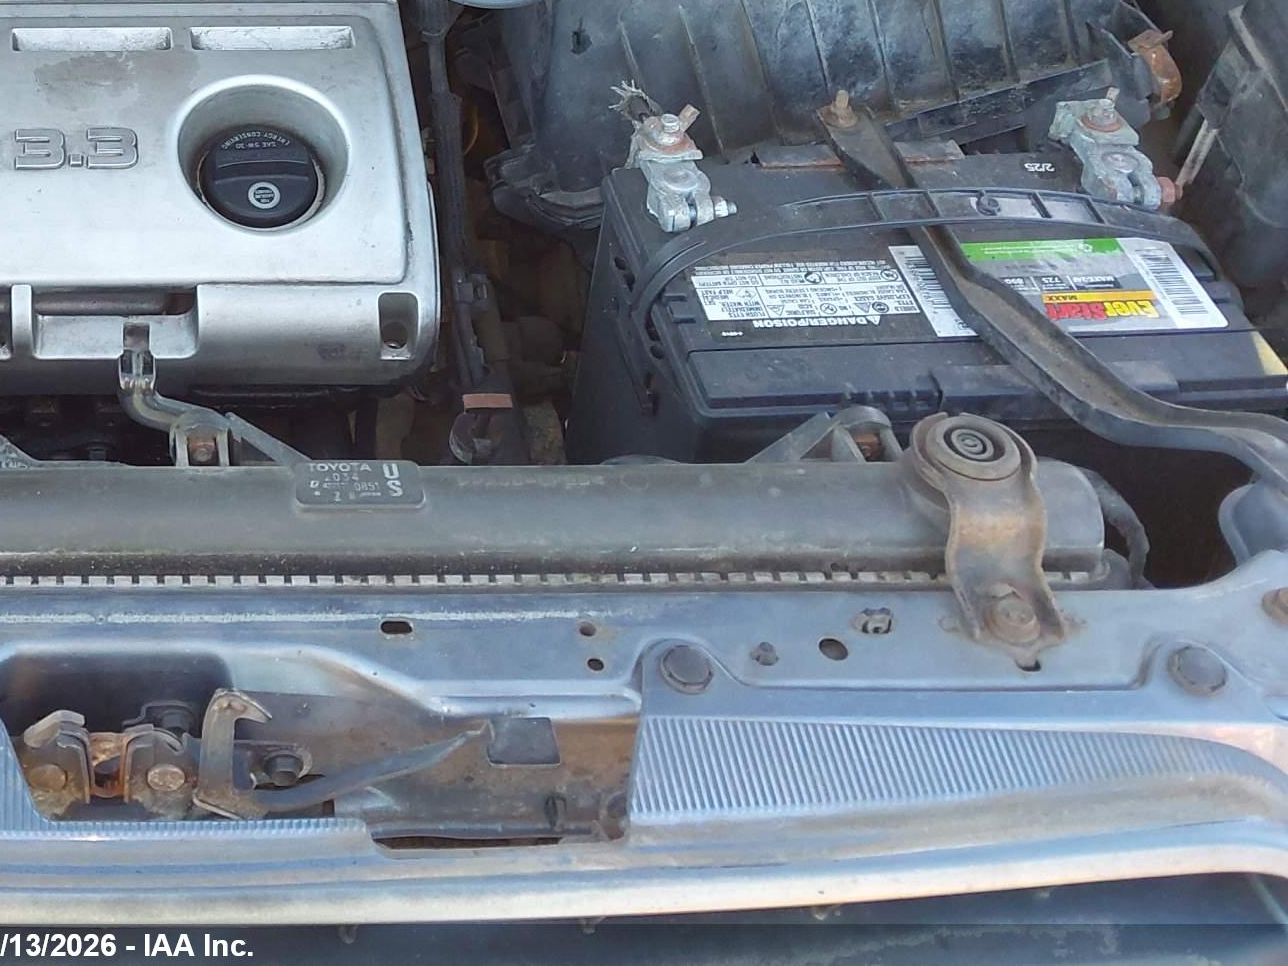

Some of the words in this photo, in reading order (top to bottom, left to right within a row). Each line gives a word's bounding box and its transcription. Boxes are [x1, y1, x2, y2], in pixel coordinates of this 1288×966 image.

[14, 126, 140, 171] 3.3
[1024, 162, 1055, 172] 2/25
[1040, 276, 1061, 284] 725
[1046, 300, 1160, 321] EverStart
[753, 317, 868, 328] DANGER/POISON
[308, 462, 372, 472] TOYOTA
